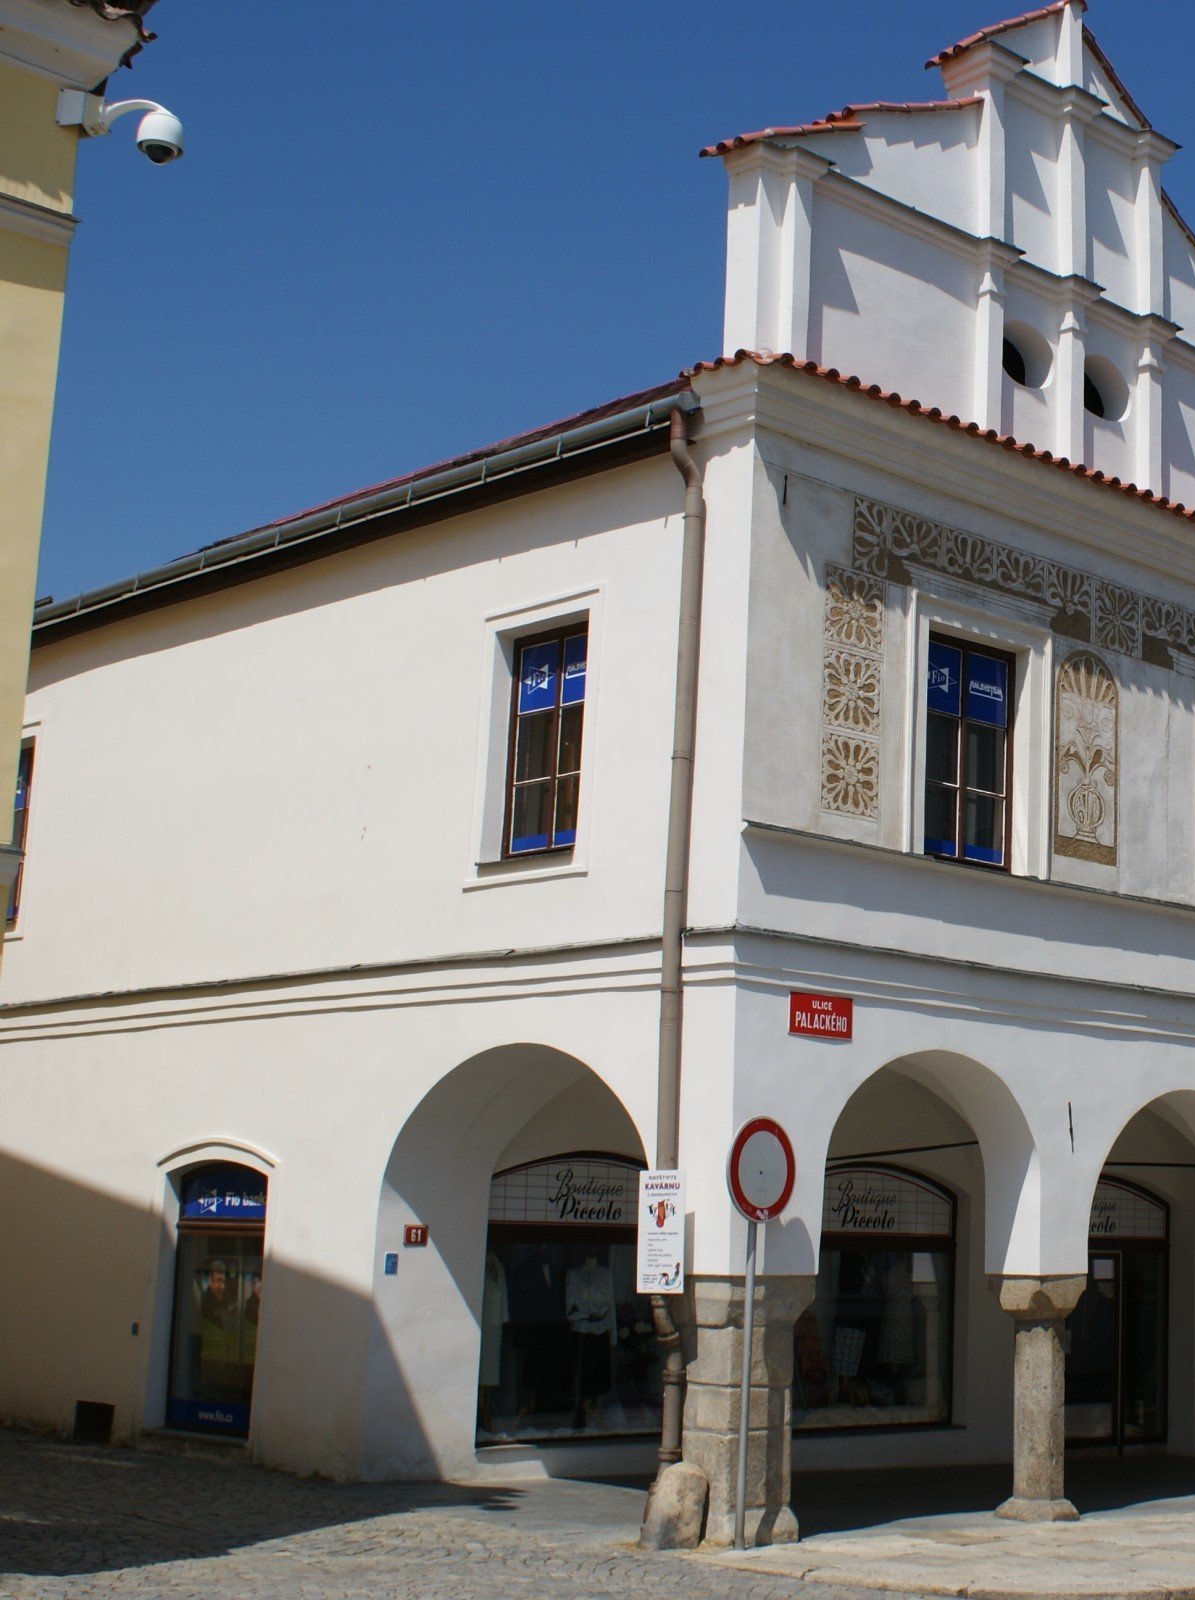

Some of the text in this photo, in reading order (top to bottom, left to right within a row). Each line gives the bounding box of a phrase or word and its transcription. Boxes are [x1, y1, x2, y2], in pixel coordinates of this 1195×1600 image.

[932, 669, 946, 684] Fio
[812, 1000, 833, 1011] ULICE
[795, 1012, 847, 1033] PALACKÉHO
[549, 1168, 624, 1206] Boutique
[645, 1182, 681, 1190] KAVÁRNU
[225, 1191, 241, 1207] Fio
[832, 1180, 897, 1215] Boutique
[560, 1195, 623, 1221] Piccolo
[841, 1205, 895, 1230] Piccolo
[411, 1229, 422, 1242] 61
